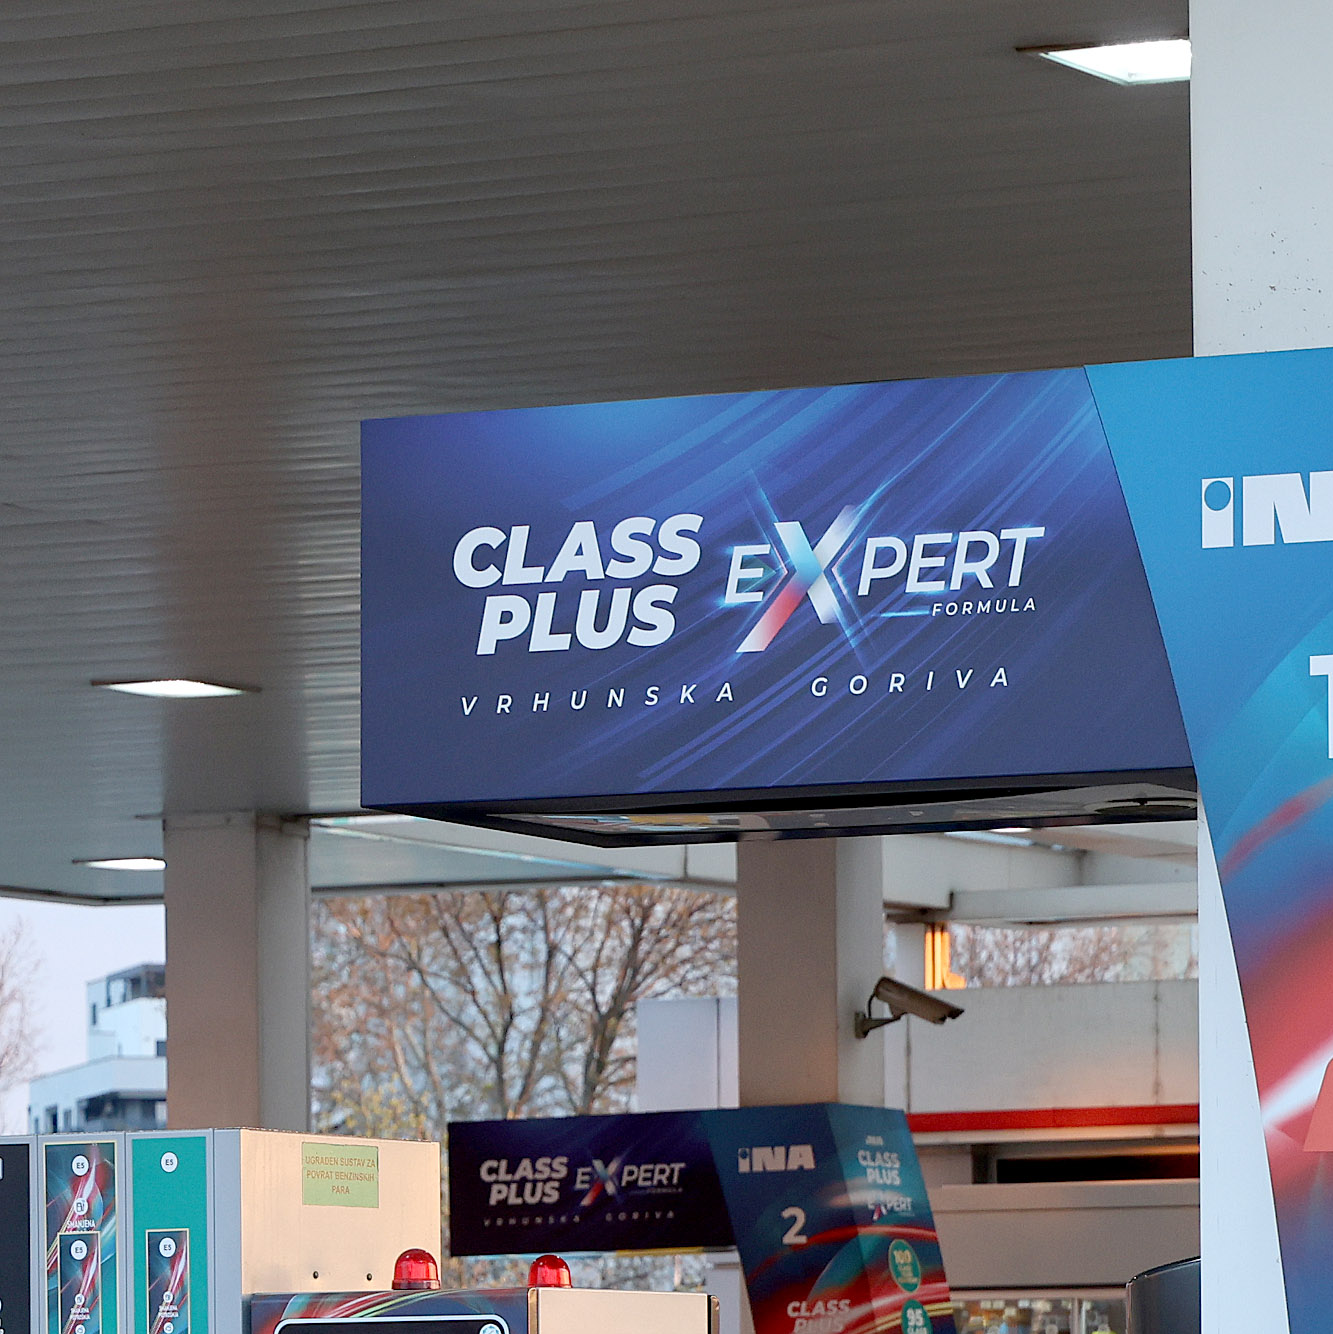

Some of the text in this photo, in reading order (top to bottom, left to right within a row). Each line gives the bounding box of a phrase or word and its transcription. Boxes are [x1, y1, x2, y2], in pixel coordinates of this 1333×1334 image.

[453, 514, 703, 589] CLASS
[726, 505, 1045, 653] EXPERT
[931, 597, 1037, 617] FORMULA
[476, 584, 676, 655] PLUS
[460, 668, 1009, 717] VRHUNSKA GORIVA
[340, 1158, 365, 1166] SUSTAV
[367, 1159, 375, 1167] ZA
[857, 1150, 900, 1168] CLASS
[307, 1170, 374, 1182] POVRAT BENZINSKIH
[480, 1156, 569, 1182] CLASS
[866, 1168, 901, 1185] PLUS
[332, 1186, 350, 1194] PARA
[489, 1181, 560, 1206] PLUS
[781, 1207, 808, 1245] 2
[787, 1300, 851, 1317] CLASS
[906, 1309, 924, 1326] 95
[794, 1316, 845, 1333] PLUS
